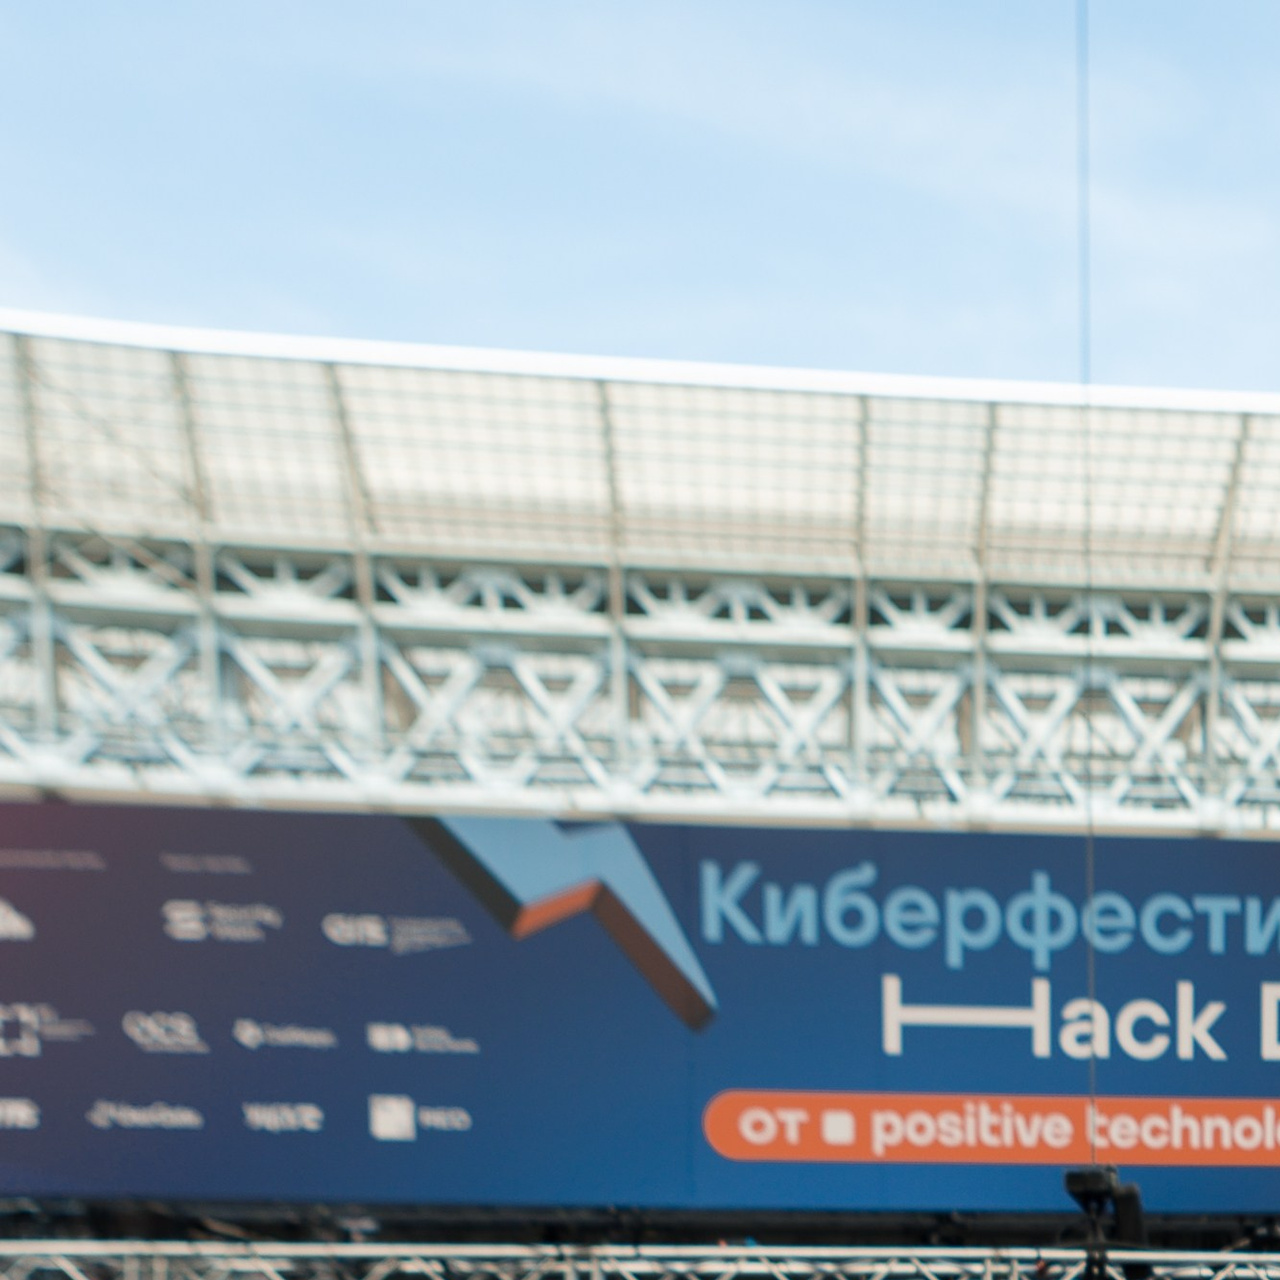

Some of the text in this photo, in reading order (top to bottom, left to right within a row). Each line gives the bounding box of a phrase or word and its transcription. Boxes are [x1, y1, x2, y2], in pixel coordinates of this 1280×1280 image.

[881, 973, 1227, 1061] Hack
[738, 1107, 809, 1145] от
[871, 1100, 1073, 1158] positive
